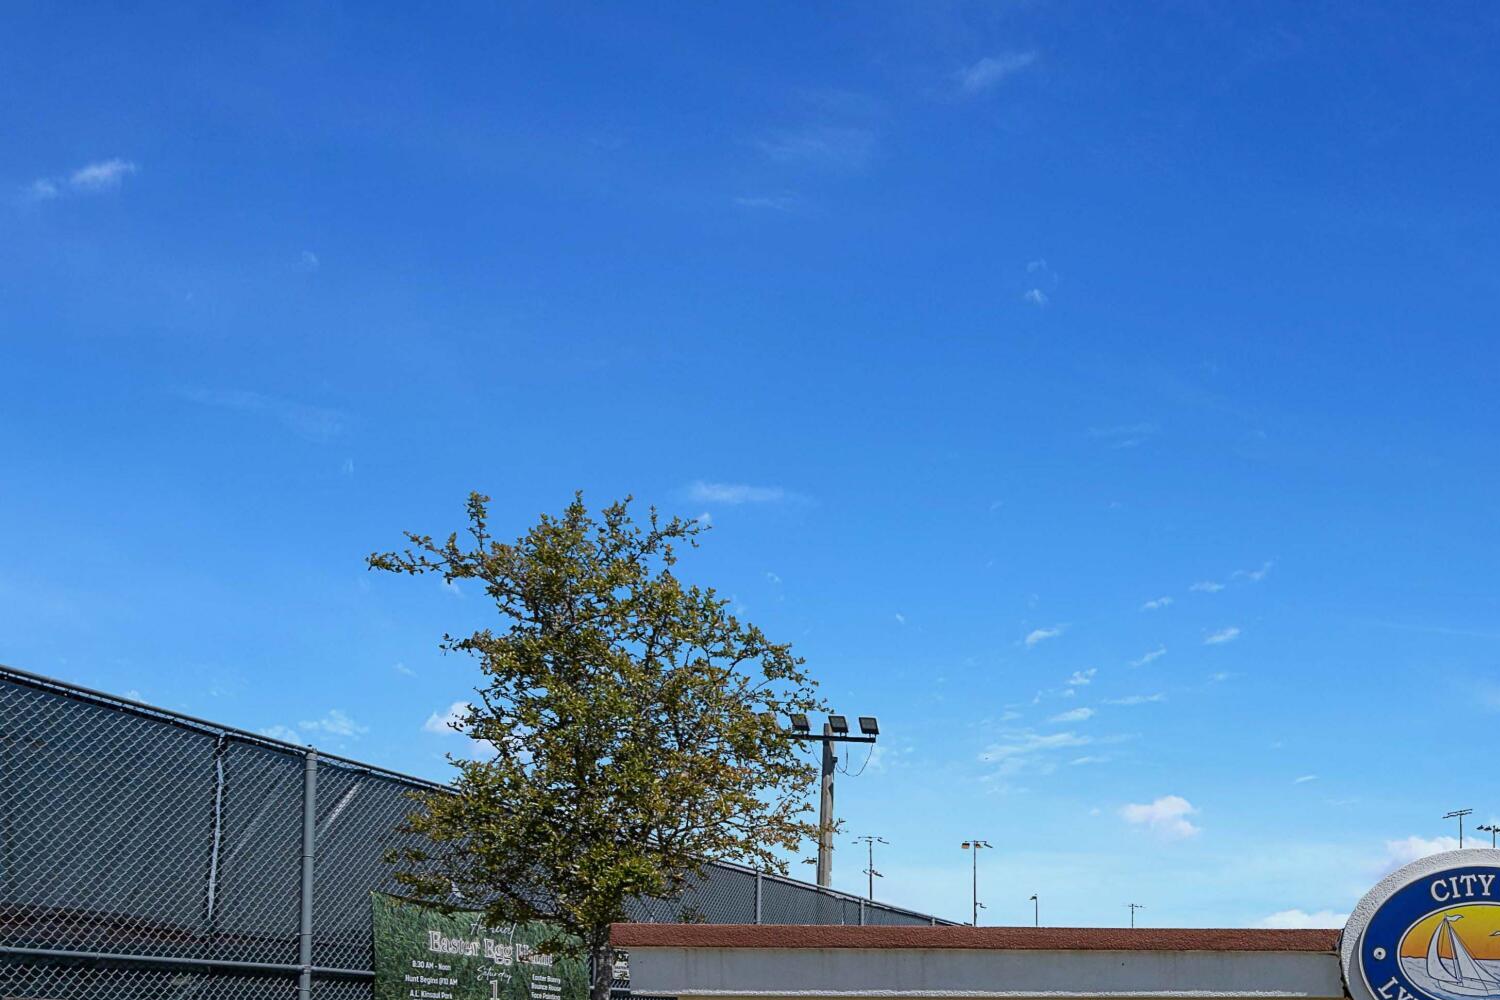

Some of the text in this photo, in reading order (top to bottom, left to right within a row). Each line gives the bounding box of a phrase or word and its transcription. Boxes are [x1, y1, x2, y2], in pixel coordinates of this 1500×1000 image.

[1430, 874, 1496, 902] CITY
[428, 930, 481, 957] Easter
[484, 939, 512, 966] Egg
